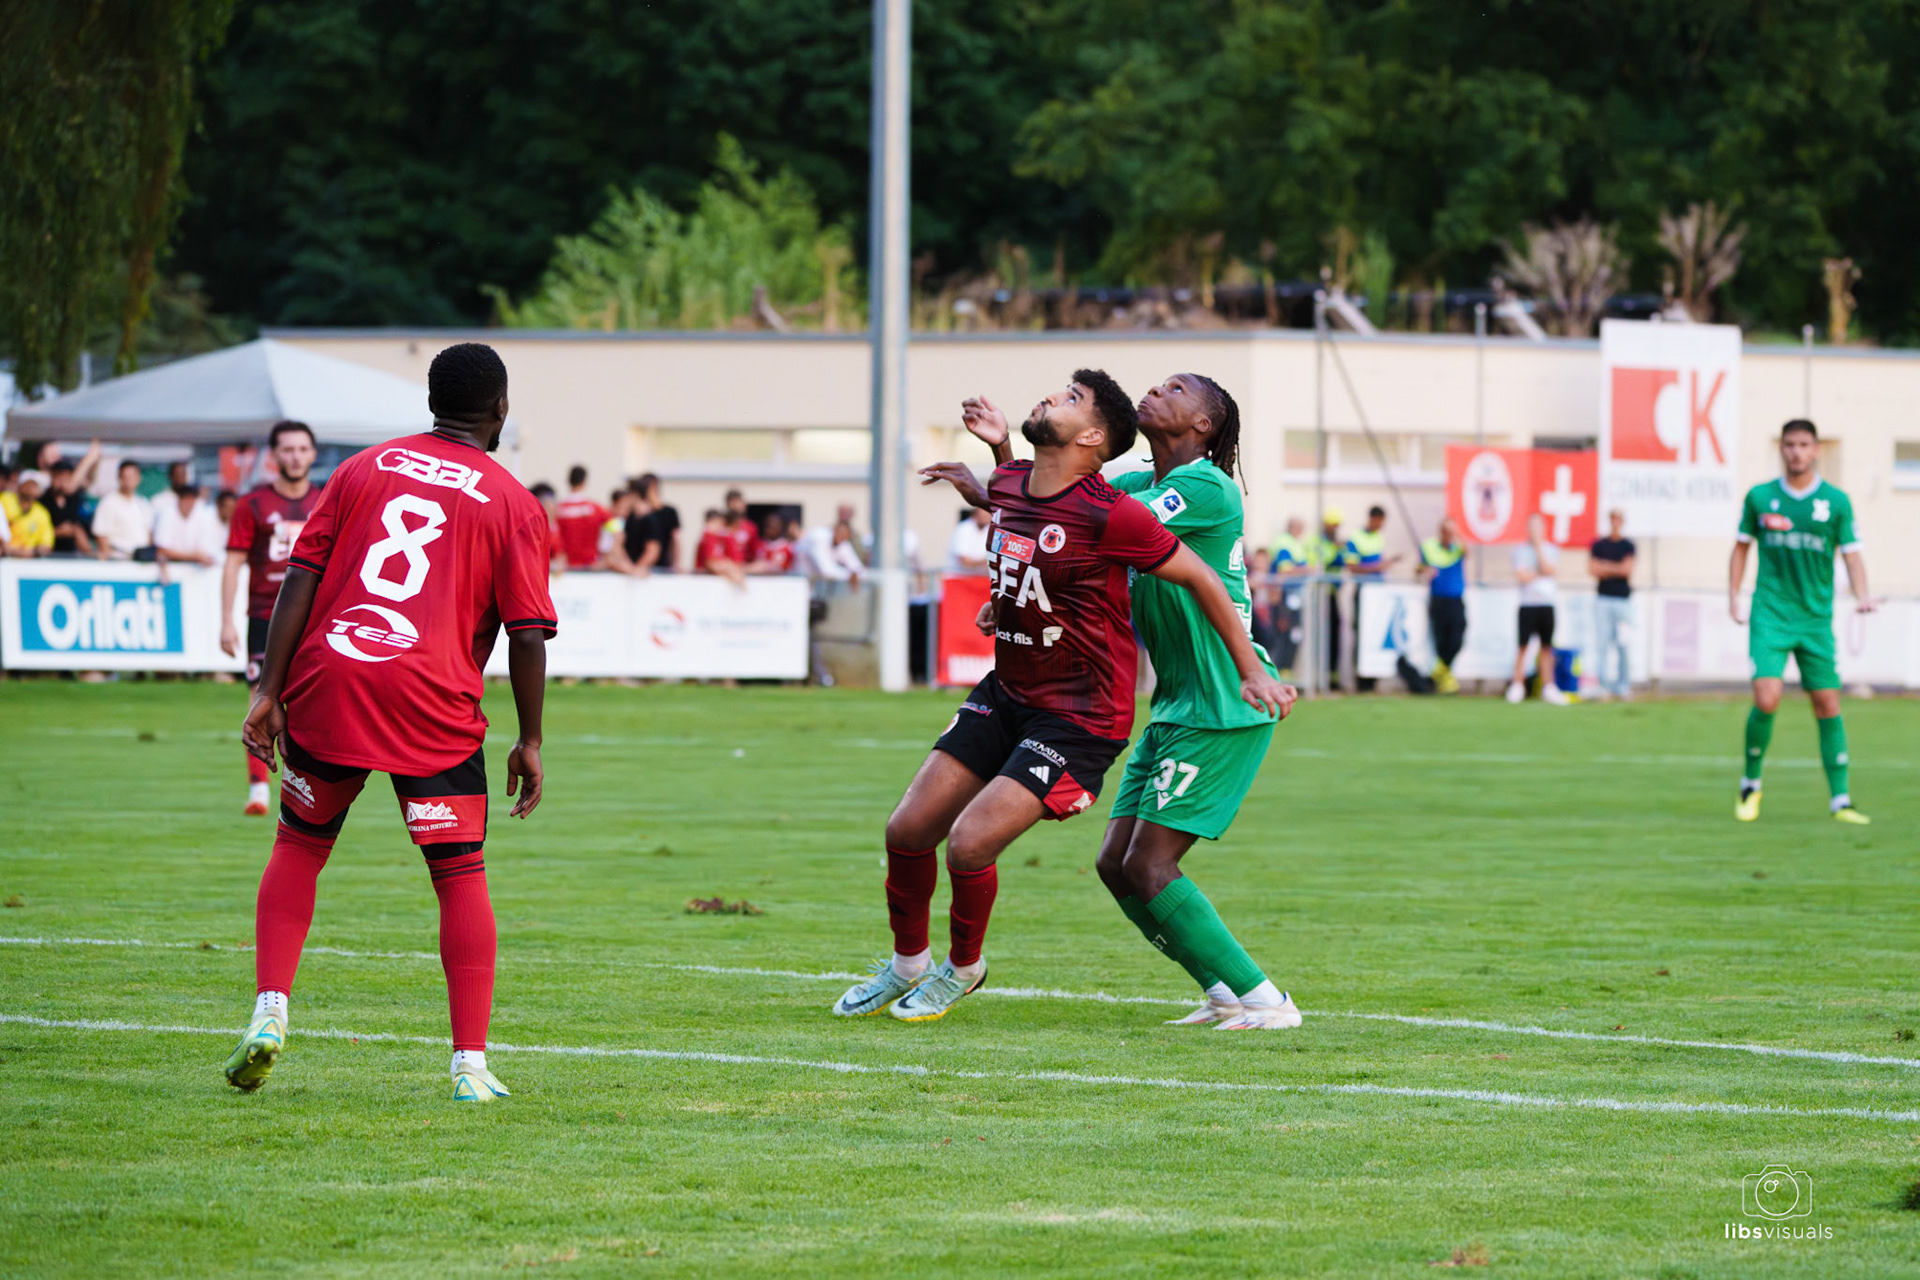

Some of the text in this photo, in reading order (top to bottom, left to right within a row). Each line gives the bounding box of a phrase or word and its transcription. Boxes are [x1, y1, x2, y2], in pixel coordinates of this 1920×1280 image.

[376, 448, 491, 504] GBBL
[360, 493, 448, 603] 8
[37, 583, 167, 650] Orllati
[331, 618, 419, 649] TES
[1012, 632, 1034, 646] fils
[1153, 757, 1200, 798] 37
